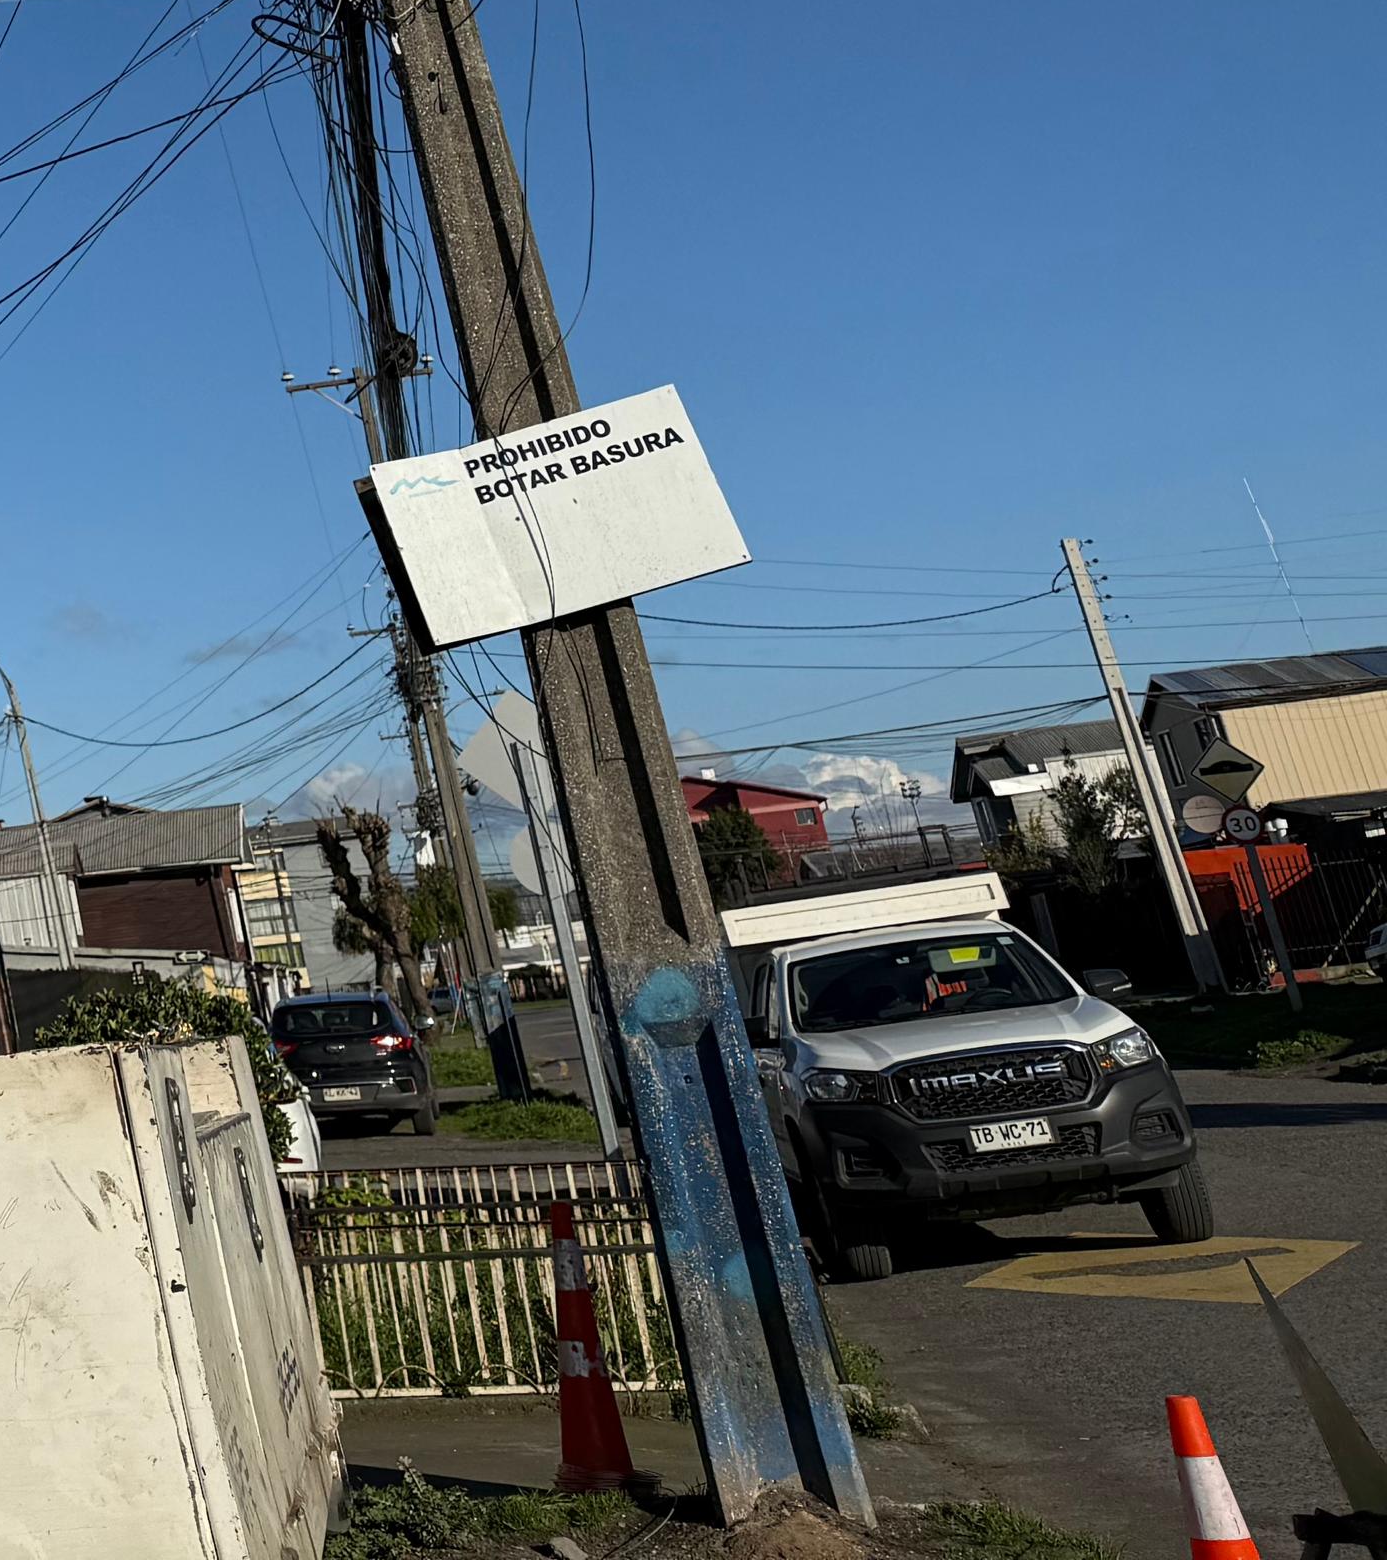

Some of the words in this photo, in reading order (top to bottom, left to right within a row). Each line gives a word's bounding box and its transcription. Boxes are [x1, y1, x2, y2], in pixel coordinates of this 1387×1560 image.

[463, 419, 611, 478] PROHIBIDO
[475, 462, 567, 505] BOTAR
[570, 427, 684, 475] BASURA
[1229, 816, 1257, 833] 30
[909, 1060, 1068, 1095] MAXUS
